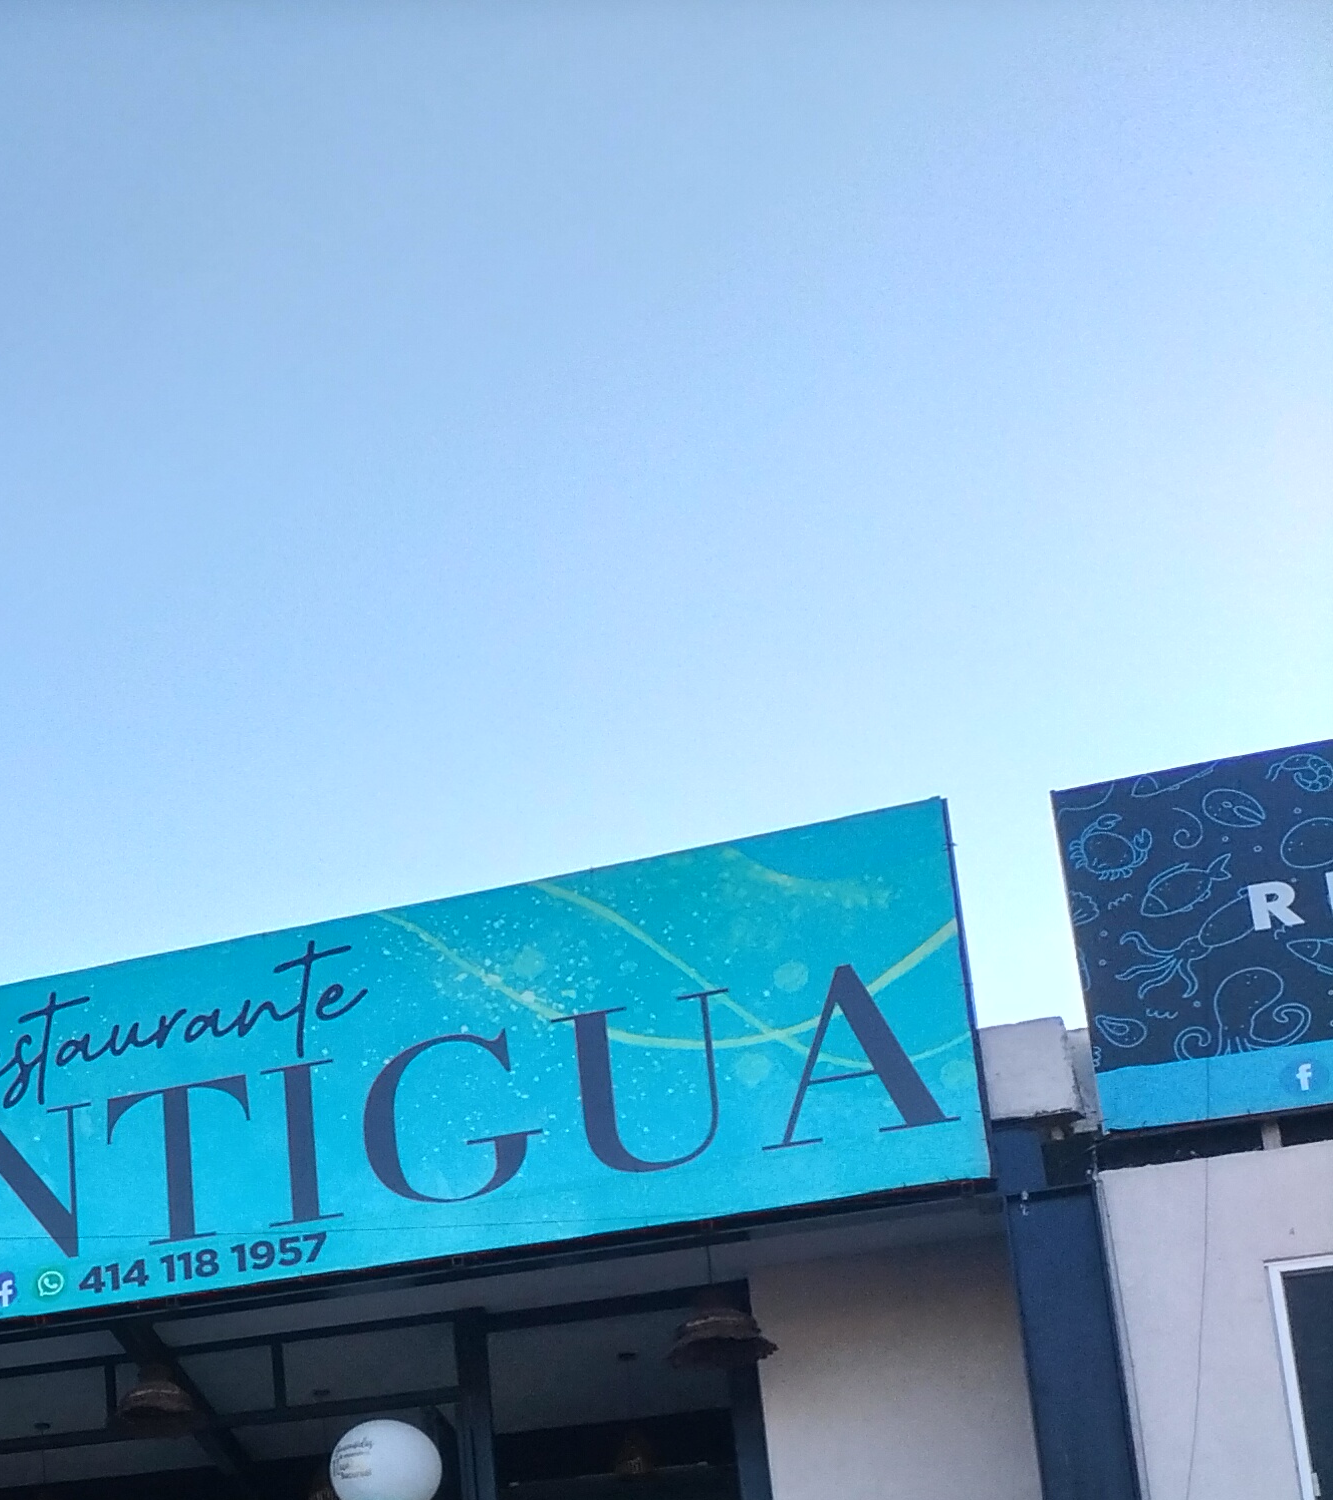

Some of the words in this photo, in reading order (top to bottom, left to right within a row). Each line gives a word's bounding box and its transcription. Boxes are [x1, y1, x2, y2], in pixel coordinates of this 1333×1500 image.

[78, 1259, 150, 1294] 414
[160, 1249, 220, 1283] 118
[230, 1233, 328, 1272] 1957
